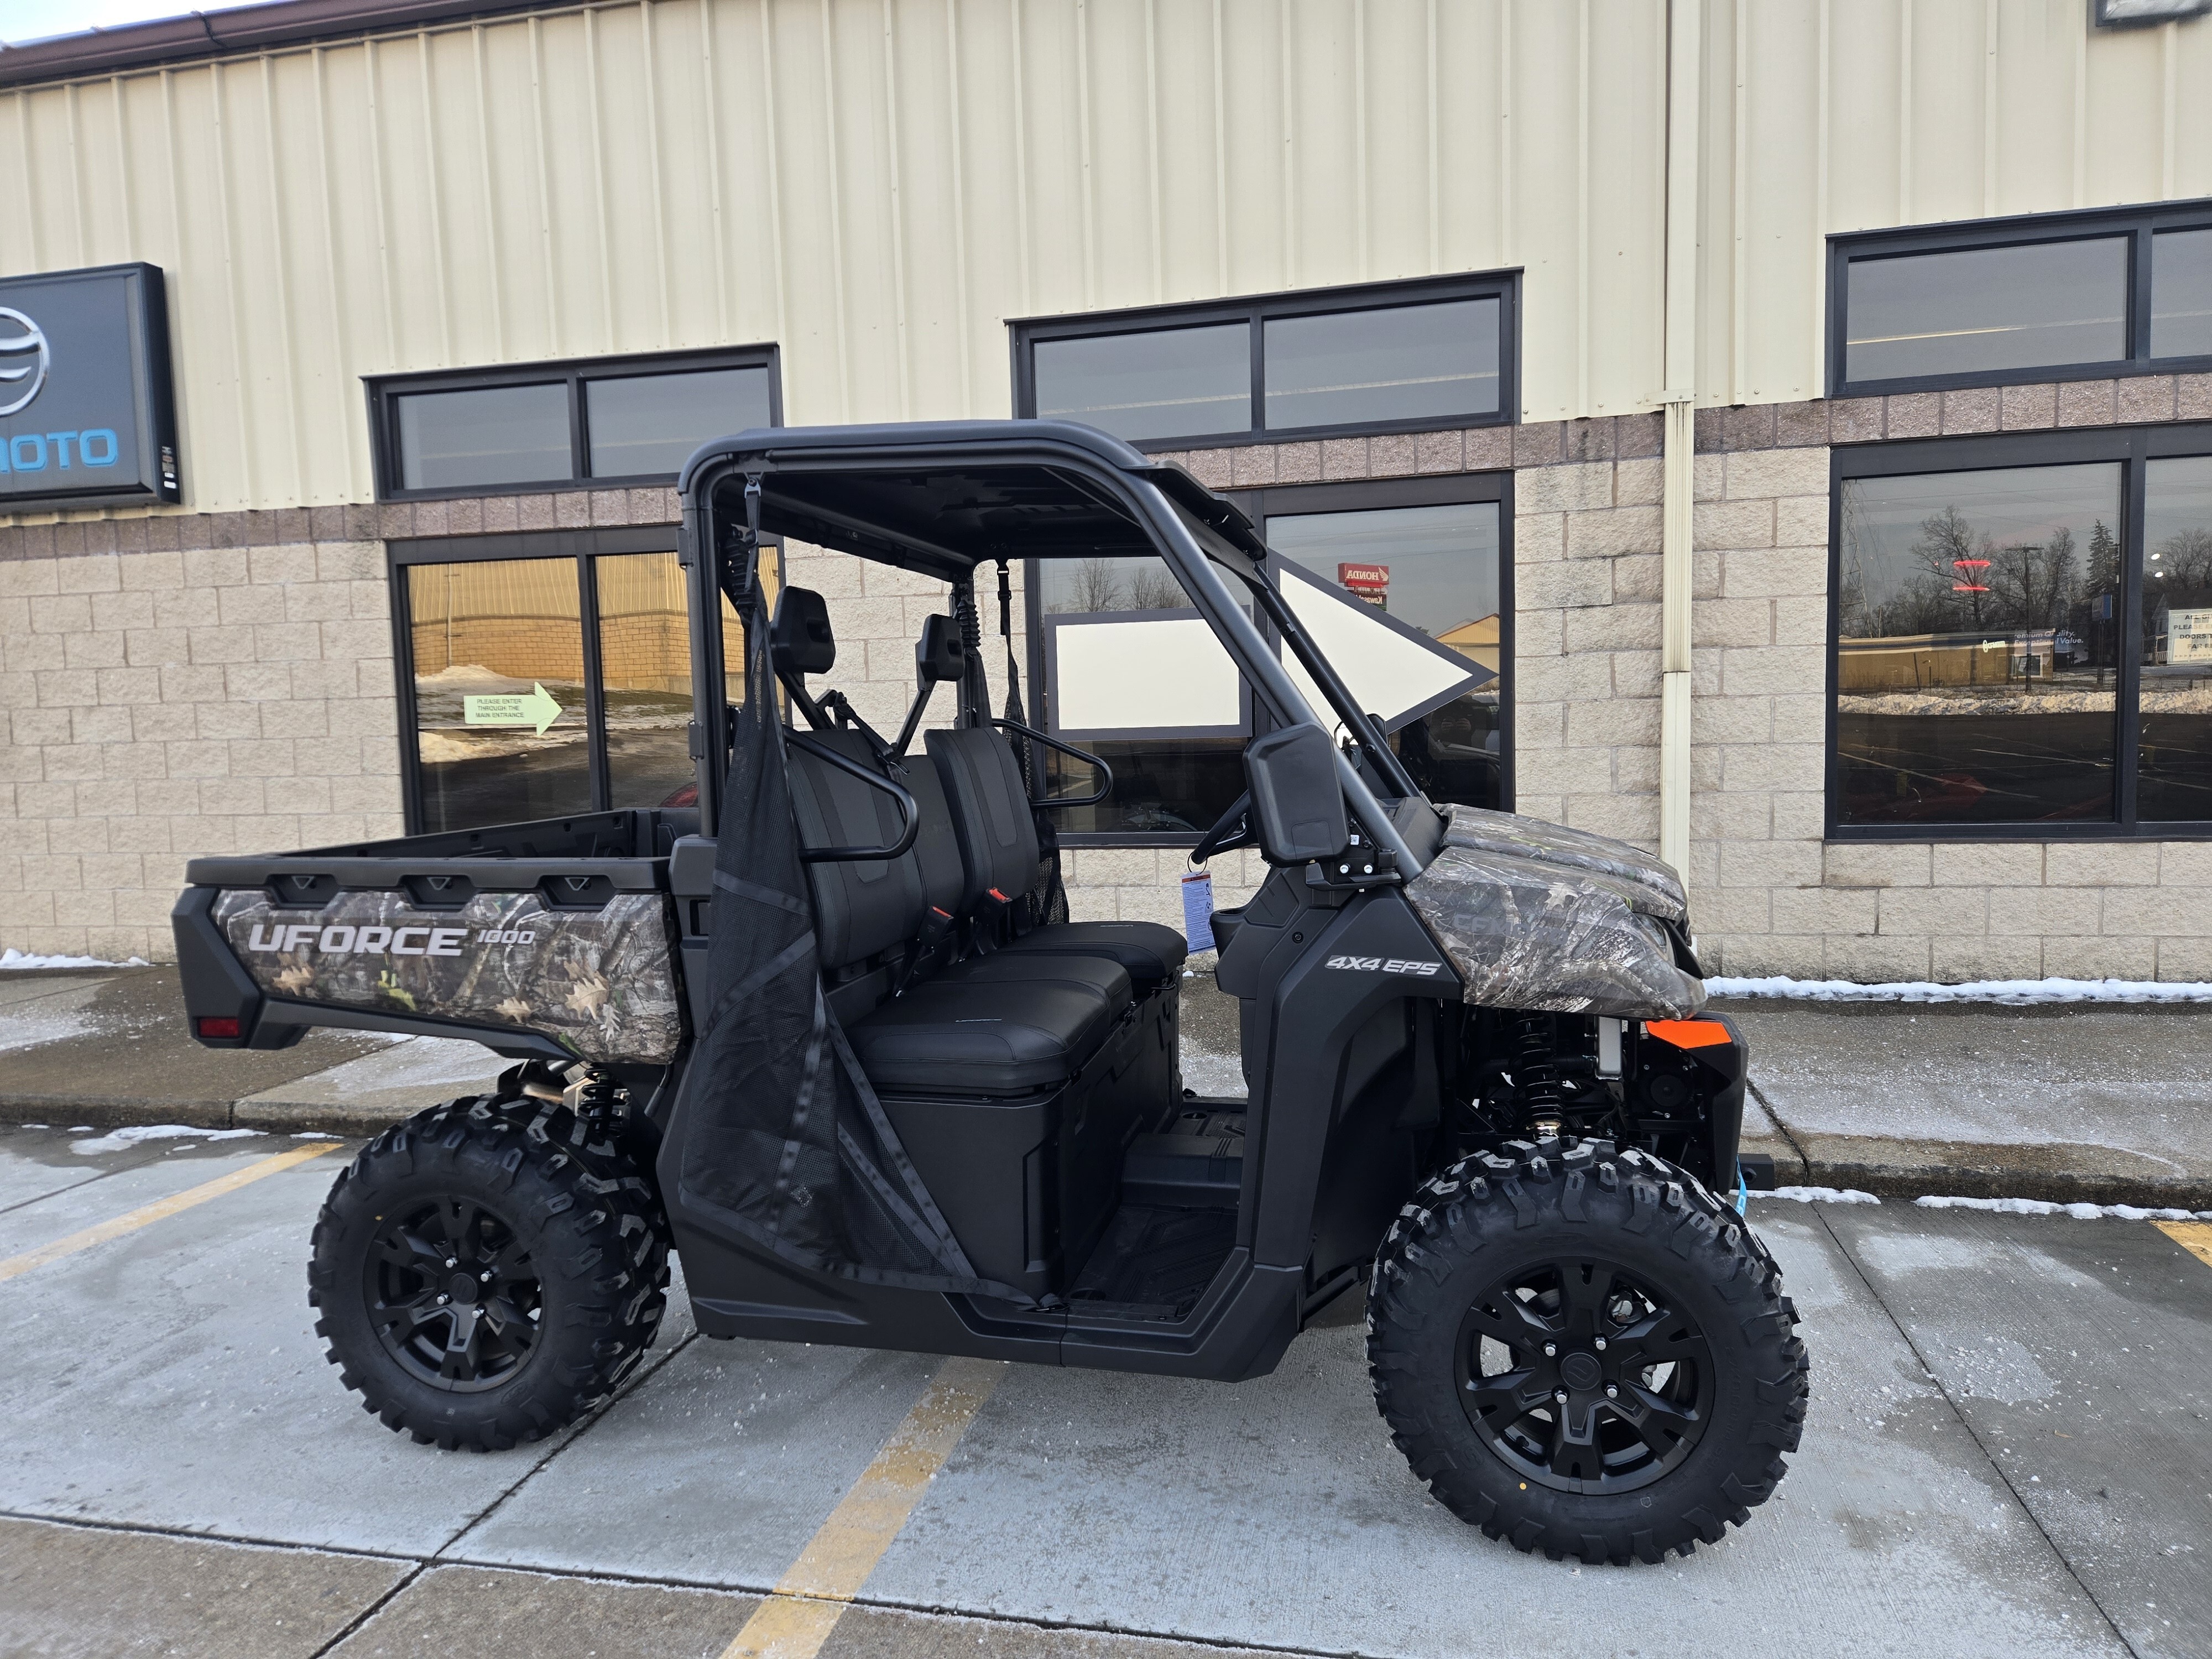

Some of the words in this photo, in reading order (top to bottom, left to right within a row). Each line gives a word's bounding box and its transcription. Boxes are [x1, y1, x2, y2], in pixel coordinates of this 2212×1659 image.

[2044, 629, 2075, 639] Qality.
[249, 924, 469, 957] UFORCE
[477, 929, 536, 945] 1000
[1327, 956, 1382, 971] 4X4
[1383, 959, 1441, 975] EPS
